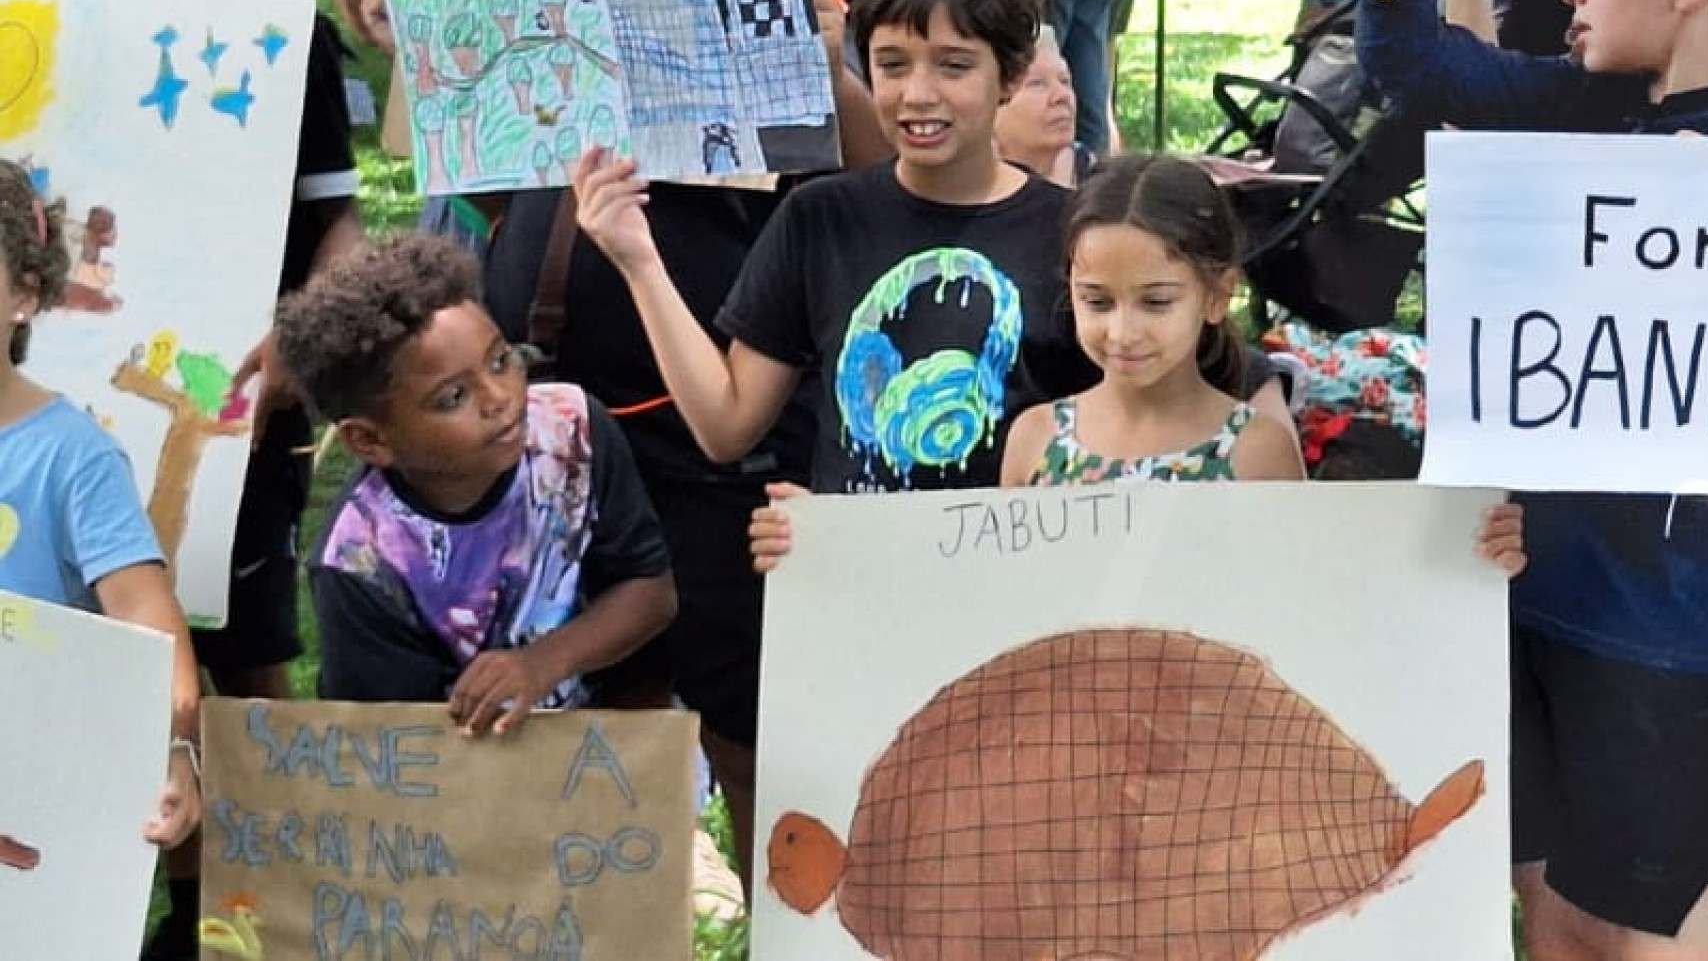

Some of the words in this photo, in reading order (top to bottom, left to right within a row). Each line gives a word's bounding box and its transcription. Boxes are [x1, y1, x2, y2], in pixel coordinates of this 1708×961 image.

[938, 492, 1134, 557] JABUTI
[246, 703, 445, 798] SALVE
[560, 715, 638, 809] A
[554, 826, 662, 886] DO
